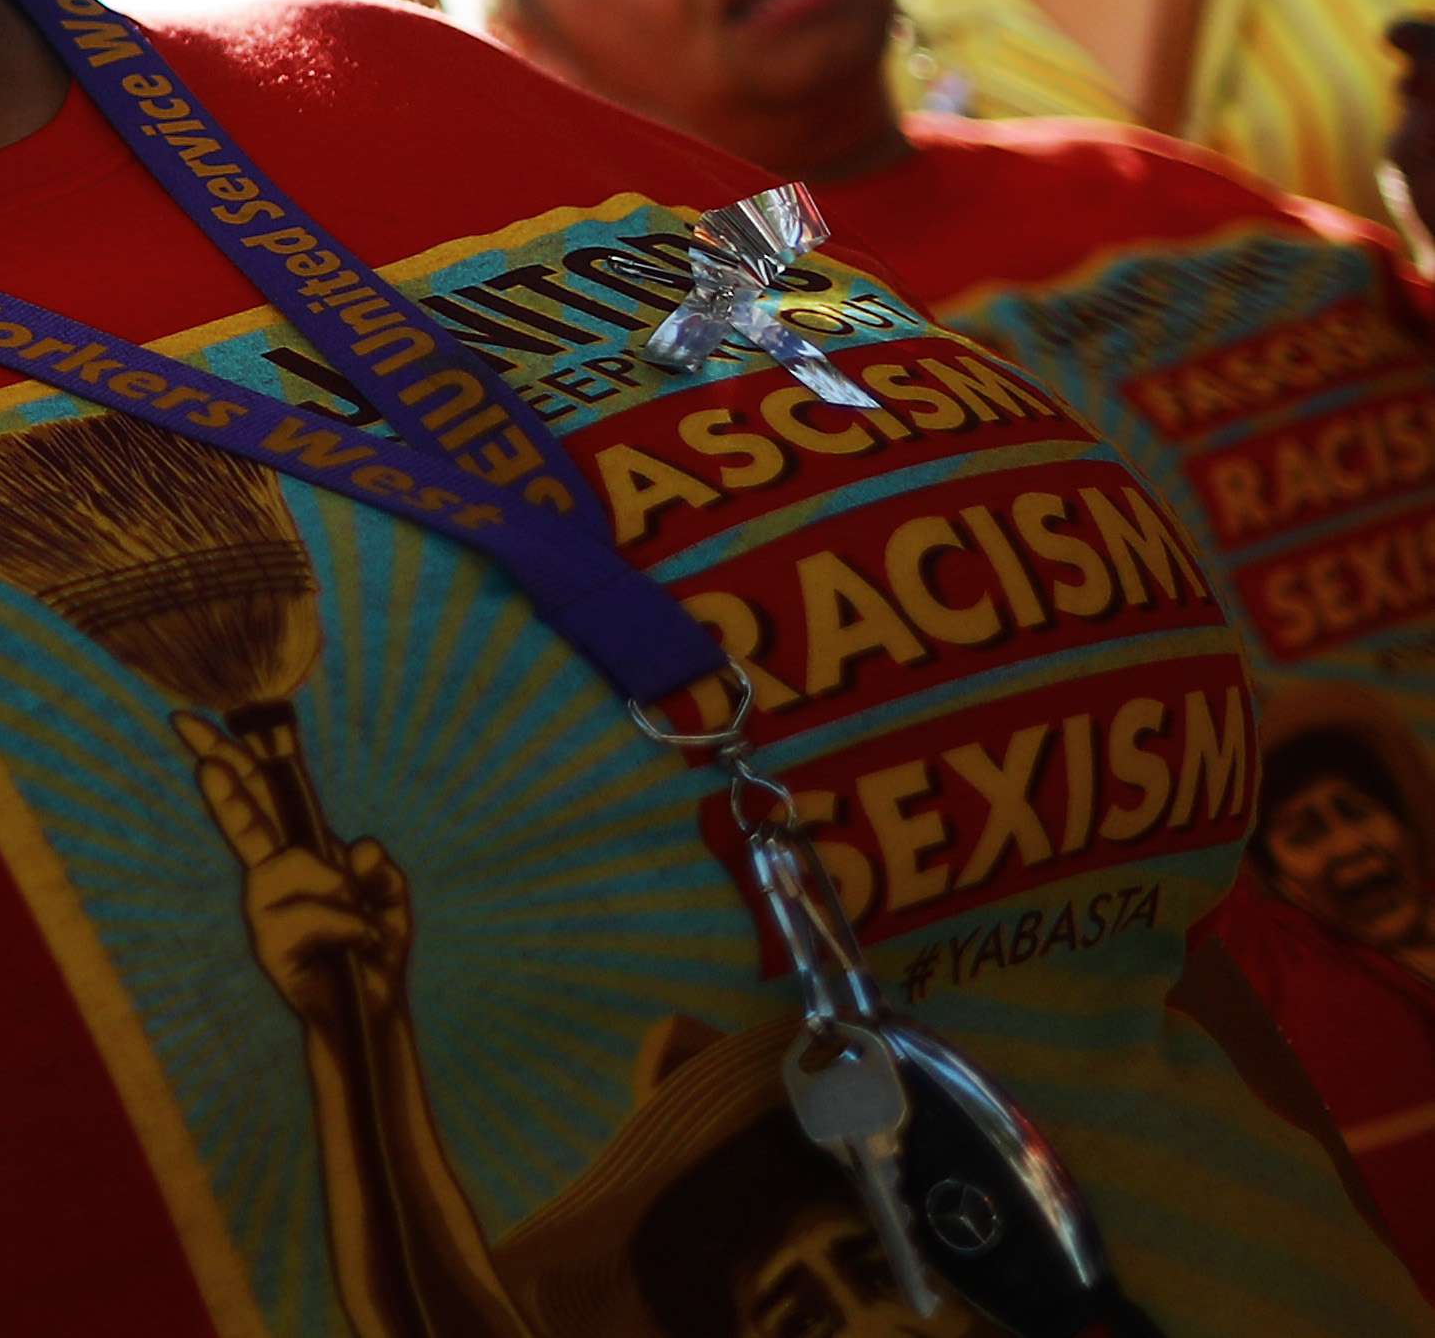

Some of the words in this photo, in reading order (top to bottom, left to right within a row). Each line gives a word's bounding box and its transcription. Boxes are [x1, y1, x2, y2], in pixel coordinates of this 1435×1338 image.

[123, 73, 286, 225] Service
[259, 227, 437, 375] United
[781, 293, 919, 335] OUT
[258, 416, 504, 531] West
[595, 363, 1055, 546] ASCISM
[681, 488, 1215, 730] RACISM
[769, 685, 1249, 929] SEXISM
[899, 883, 1161, 1003] #YABASTA
